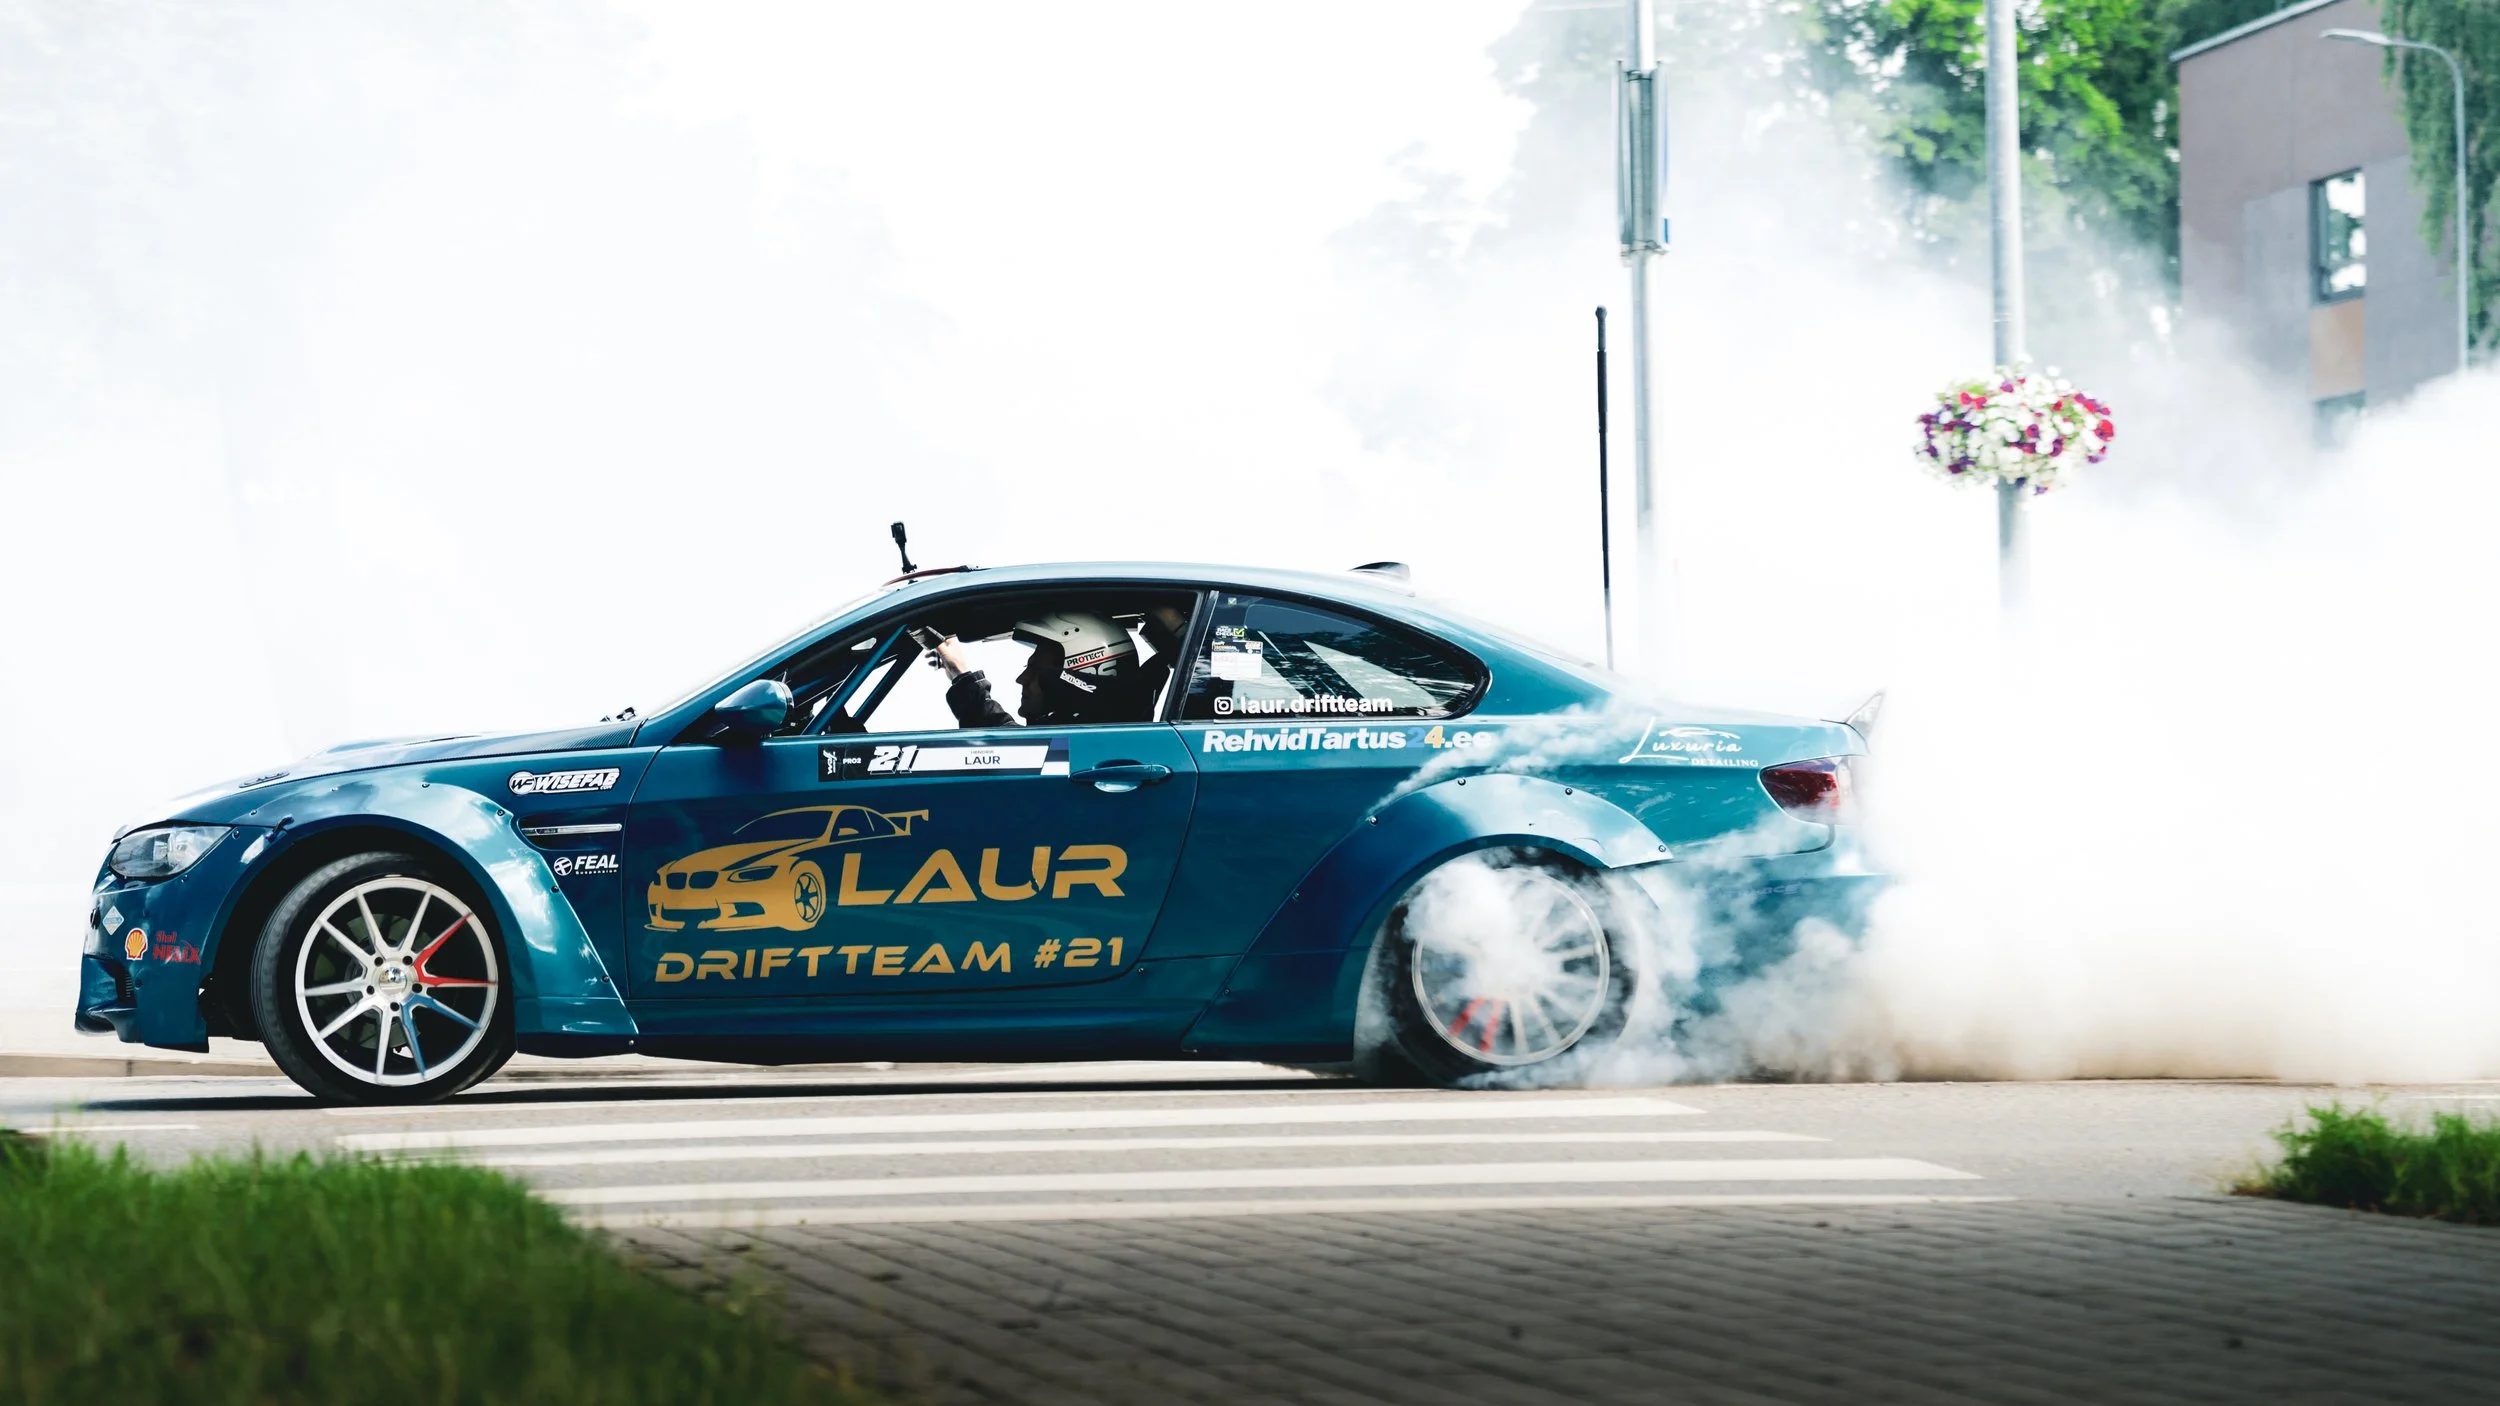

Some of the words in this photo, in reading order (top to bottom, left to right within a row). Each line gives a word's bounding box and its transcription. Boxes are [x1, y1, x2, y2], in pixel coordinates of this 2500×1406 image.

[1066, 650, 1105, 667] PROTECT
[1240, 695, 1394, 714] laur.driftteam
[1203, 725, 1493, 752] RehvidTartus24.ee
[1618, 716, 1743, 764] Luxuria
[867, 745, 918, 775] 21
[964, 755, 1001, 766] LAUR
[1691, 758, 1759, 767] DETAILING
[534, 772, 619, 791] WISEFAB
[574, 854, 620, 870] FEAL
[837, 844, 1129, 906] LAUR
[155, 931, 178, 943] Shell
[152, 944, 202, 965] HELIX
[655, 941, 1012, 984] DRIFTTEAM
[1033, 936, 1124, 970] #21
